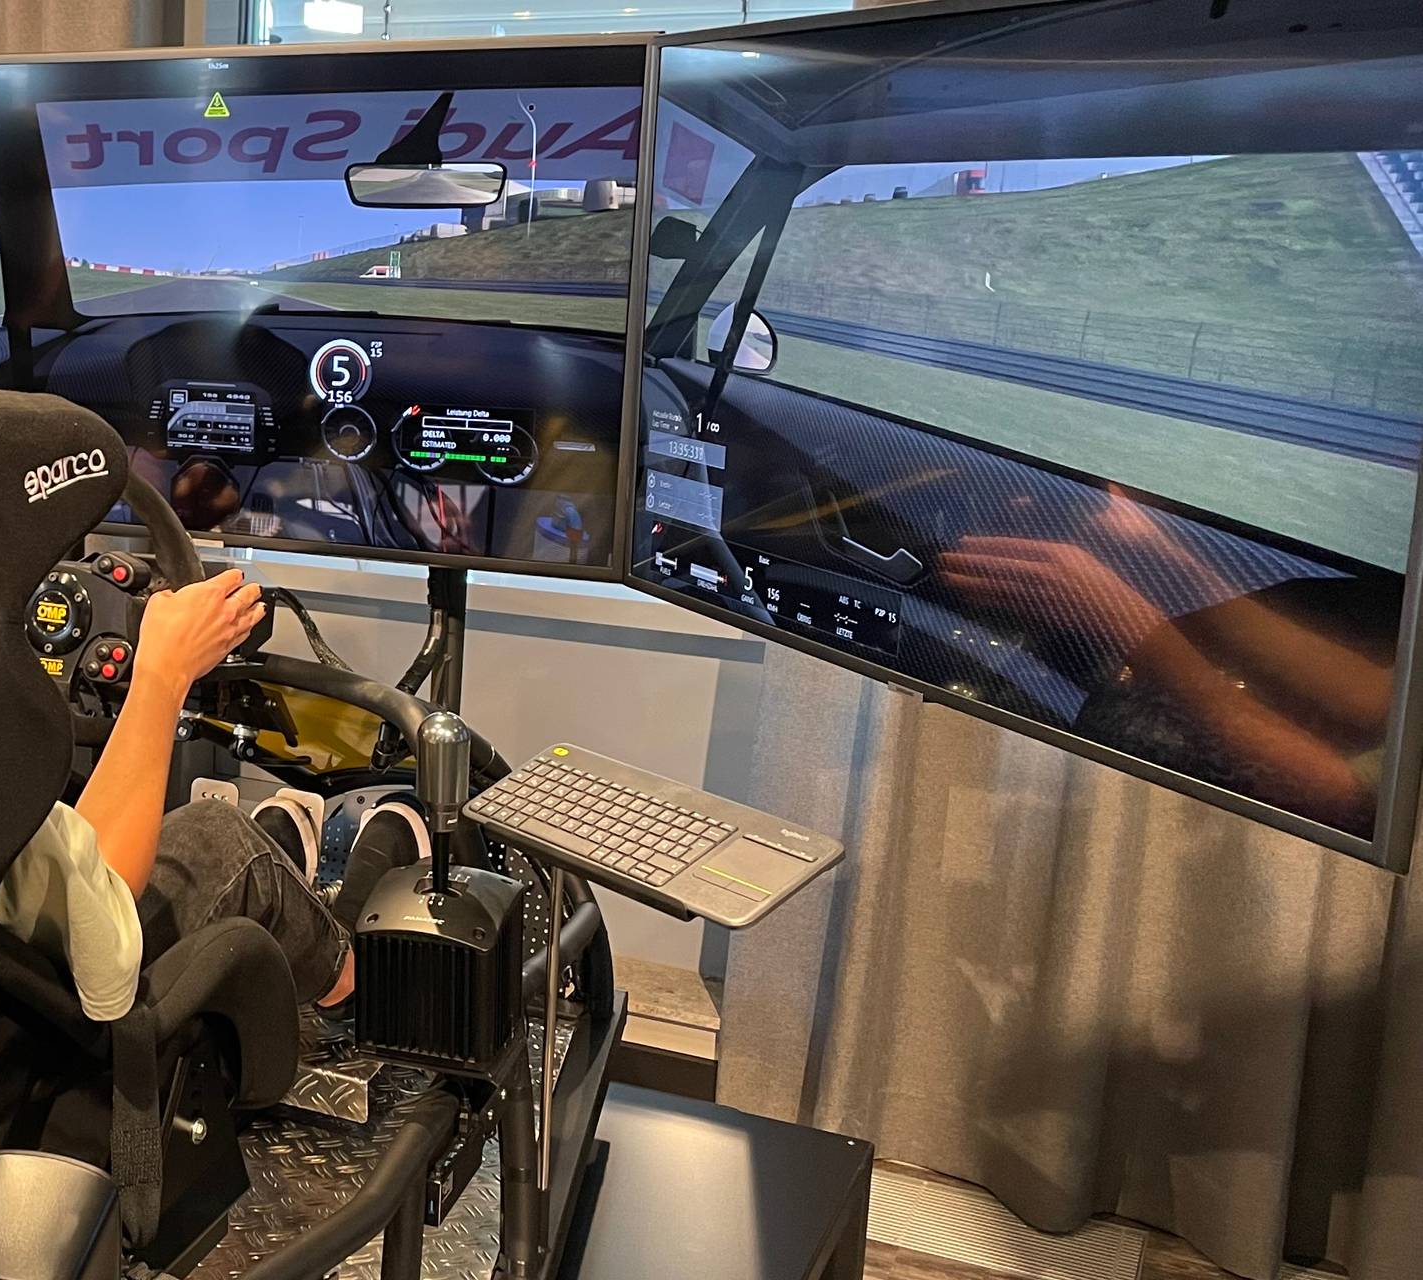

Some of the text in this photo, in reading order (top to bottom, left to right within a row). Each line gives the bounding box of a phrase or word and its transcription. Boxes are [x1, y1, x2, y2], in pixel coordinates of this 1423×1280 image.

[370, 348, 383, 358] 15
[331, 355, 350, 387] 5
[327, 389, 353, 404] 156
[473, 409, 490, 418] Delta
[422, 430, 512, 443] DELTA 0.000
[422, 440, 457, 450] ESTIMATED
[24, 448, 106, 500] sparco
[744, 566, 754, 591] 5
[767, 587, 780, 601] 156
[37, 605, 67, 620] OMP
[887, 612, 897, 624] 15
